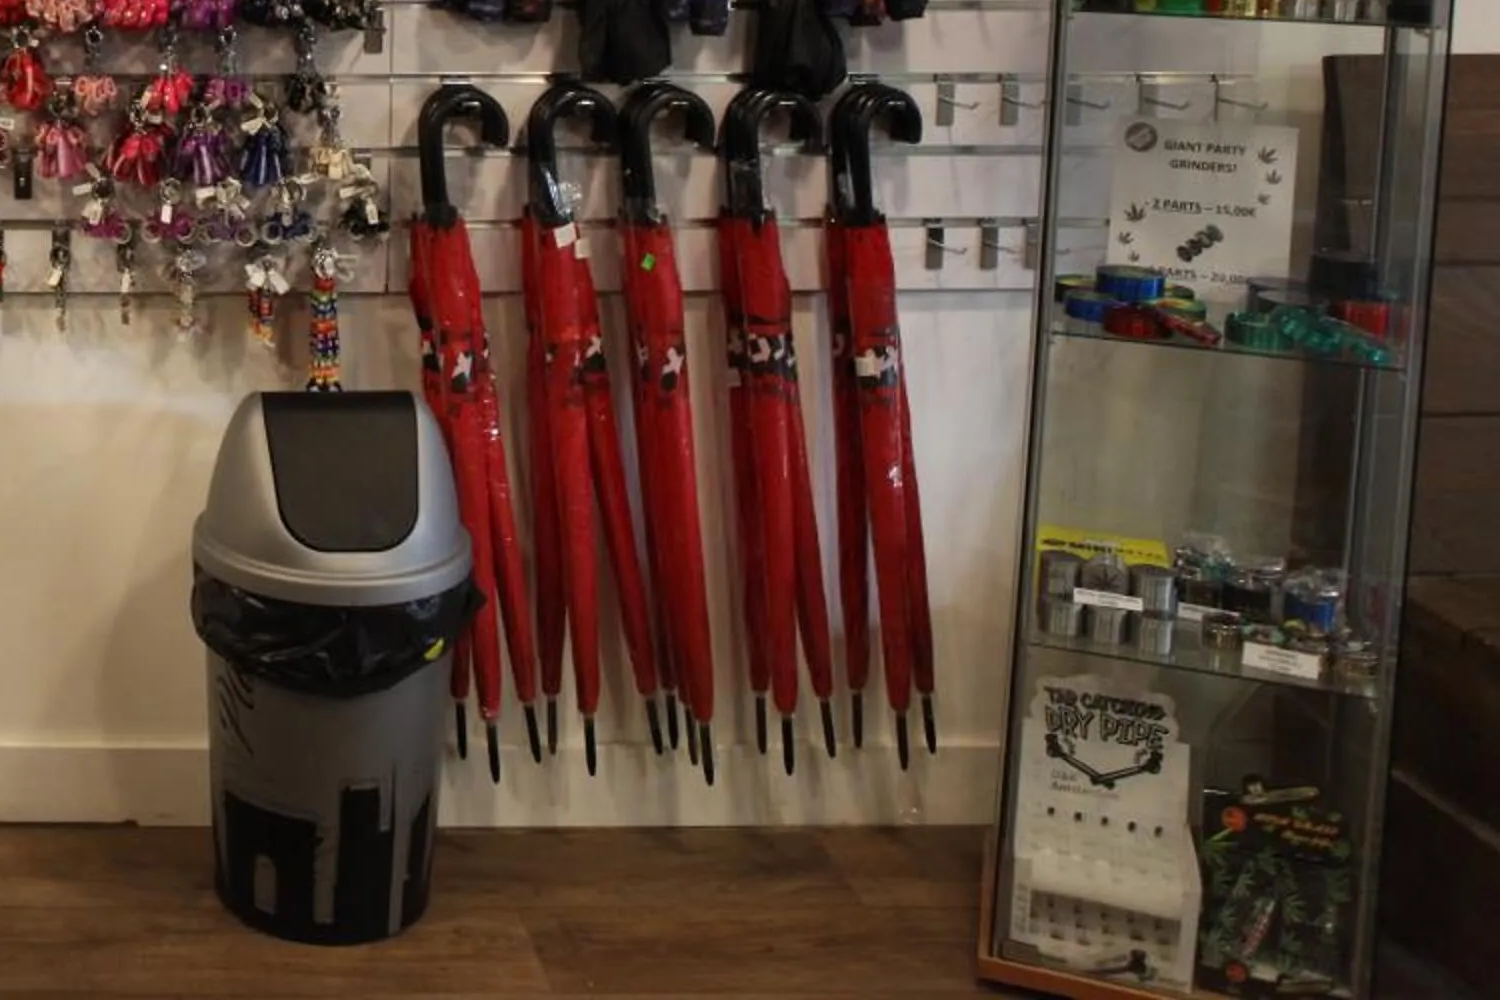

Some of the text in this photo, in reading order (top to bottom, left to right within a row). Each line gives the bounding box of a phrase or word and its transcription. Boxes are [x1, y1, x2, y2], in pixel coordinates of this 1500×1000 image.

[1164, 139, 1247, 156] GIANT PARTY
[1163, 199, 1202, 214] PARTS
[1044, 704, 1170, 752] DRY PIPE
